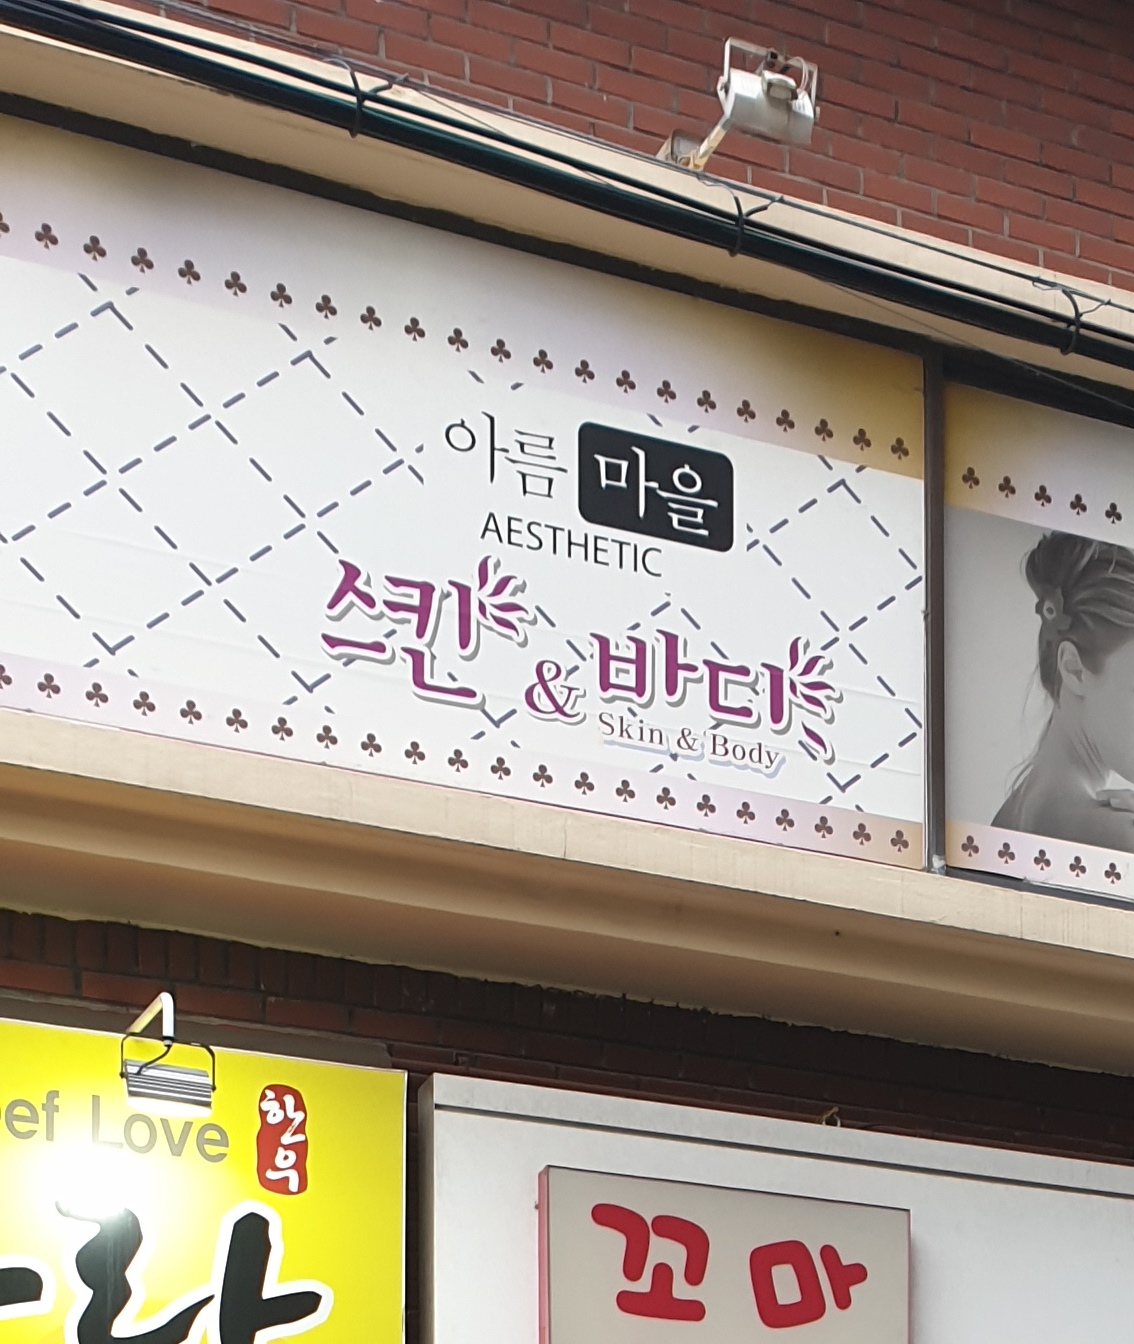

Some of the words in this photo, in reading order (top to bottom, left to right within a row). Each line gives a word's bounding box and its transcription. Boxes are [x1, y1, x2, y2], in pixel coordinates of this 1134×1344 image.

[445, 411, 568, 499] 아름
[593, 446, 719, 537] 마을
[480, 511, 663, 577] AESTHETIC
[321, 556, 525, 702] 스킨
[524, 658, 584, 718] &
[590, 629, 835, 742] 바디
[597, 711, 665, 748] Skin
[675, 727, 698, 752] &
[709, 733, 781, 768] Body
[0, 1090, 60, 1142] ef
[91, 1094, 230, 1163] Love
[259, 1089, 306, 1193] 한우
[591, 1203, 868, 1329] 꼬마
